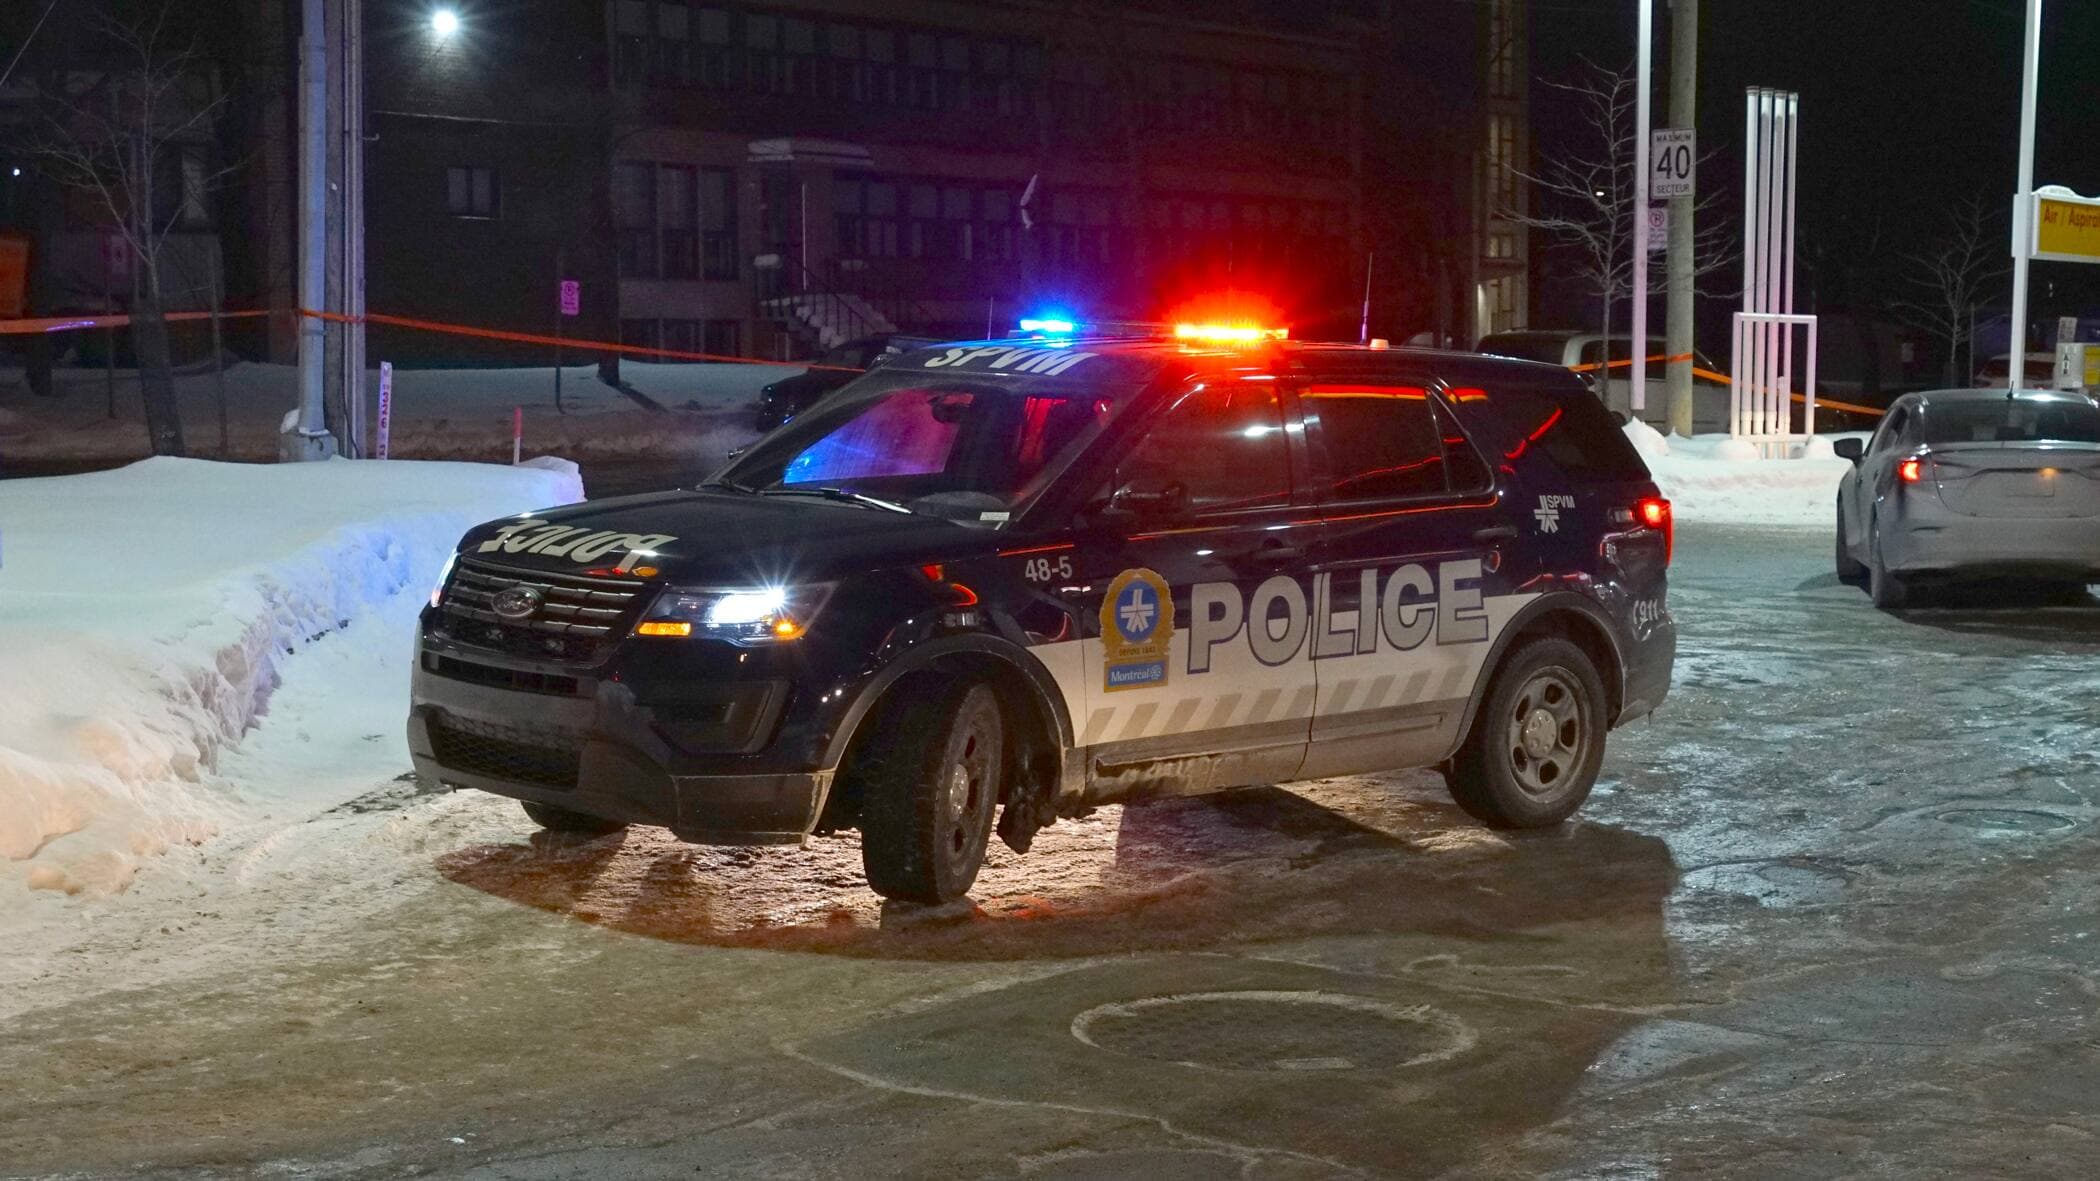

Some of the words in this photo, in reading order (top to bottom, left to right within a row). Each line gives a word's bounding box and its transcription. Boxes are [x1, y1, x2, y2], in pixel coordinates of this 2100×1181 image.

[1656, 144, 1691, 180] 40
[1656, 184, 1690, 194] SECTEUR
[2044, 205, 2058, 224] Air
[924, 346, 1100, 376] SPVM
[1547, 495, 1575, 508] SPVM
[1025, 555, 1073, 582] 48-5
[1187, 557, 1489, 675] POLICE
